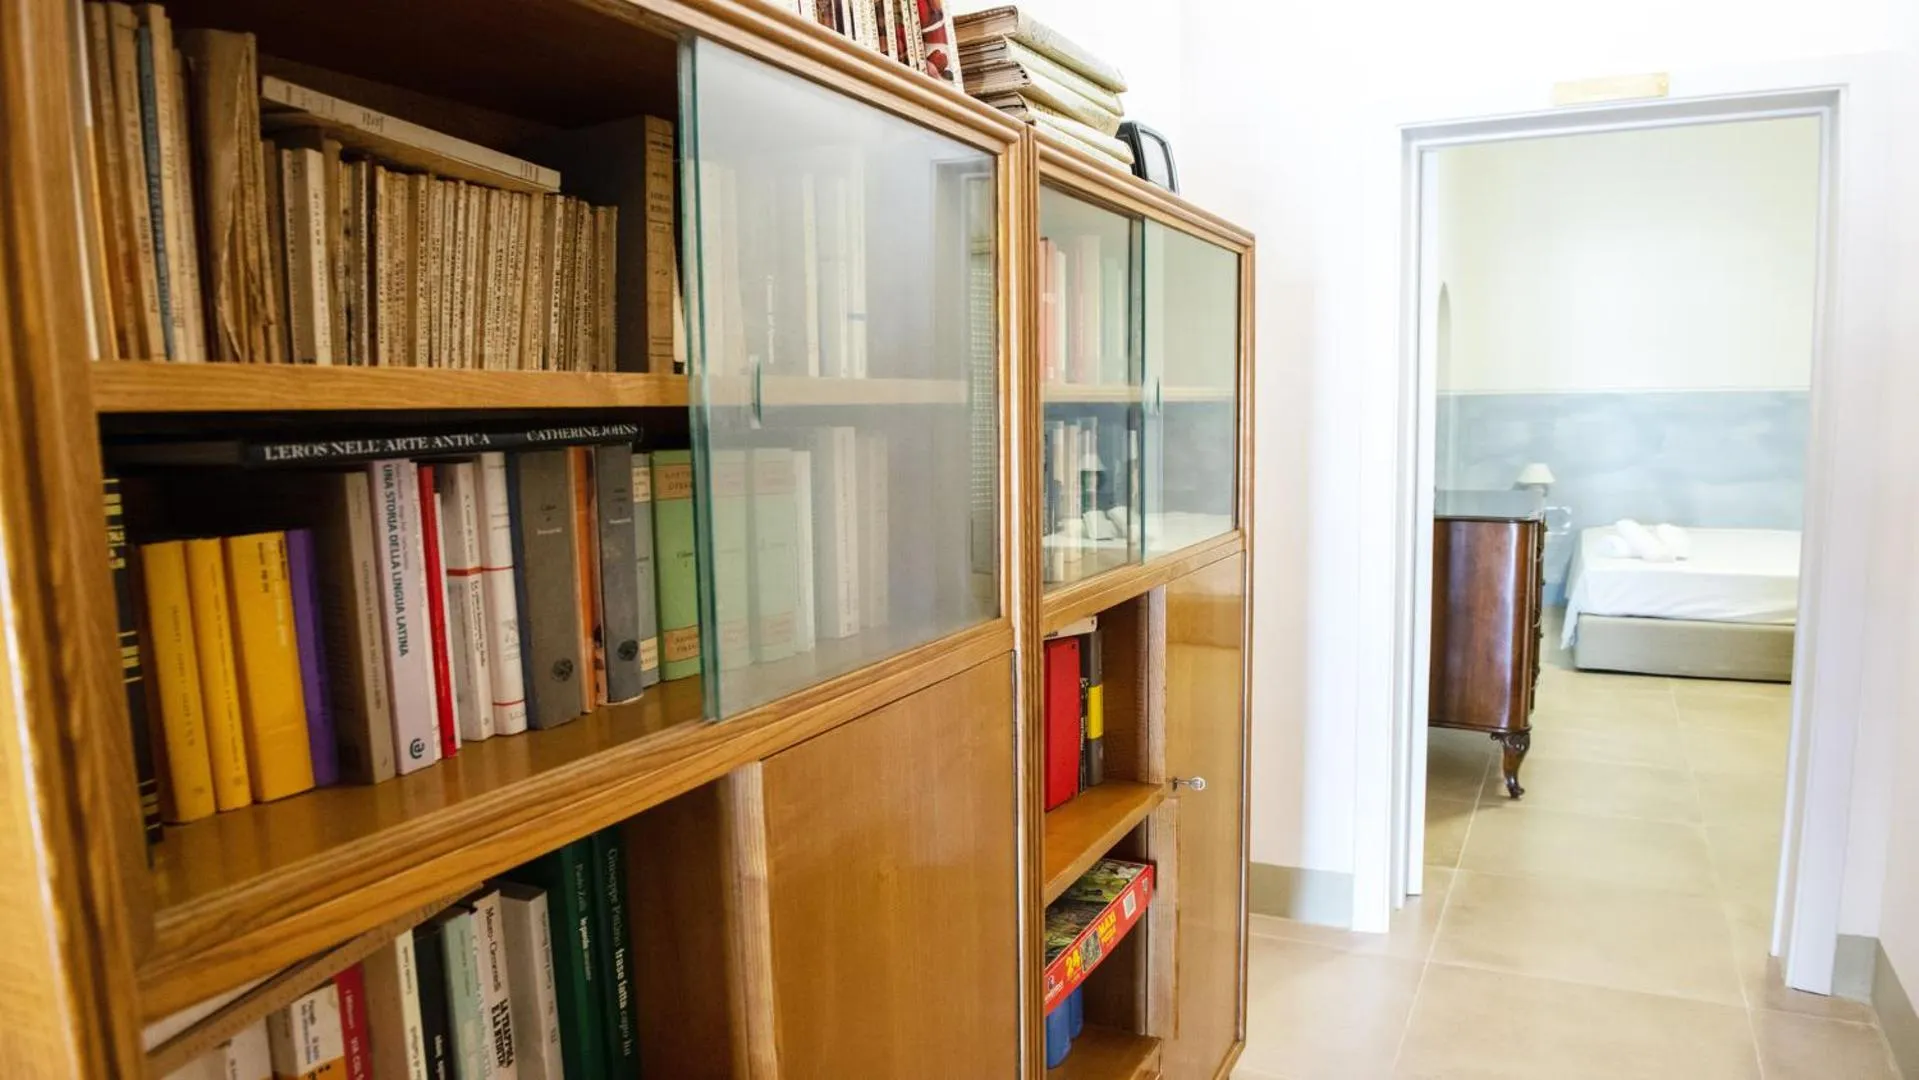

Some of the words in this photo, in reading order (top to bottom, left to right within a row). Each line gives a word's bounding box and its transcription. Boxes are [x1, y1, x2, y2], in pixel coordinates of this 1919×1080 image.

[526, 426, 600, 441] CATHERINE
[601, 422, 639, 437] JOHNS
[264, 443, 328, 461] L'EROS
[431, 433, 490, 448] ANTICA
[383, 464, 394, 489] UNA
[385, 491, 398, 533] STORIA
[389, 534, 401, 570] DELLA
[391, 571, 405, 615] LINGUA
[396, 615, 409, 658] LATINA
[616, 948, 625, 980] frase
[1066, 949, 1081, 978] 24
[618, 980, 628, 1009] fatta
